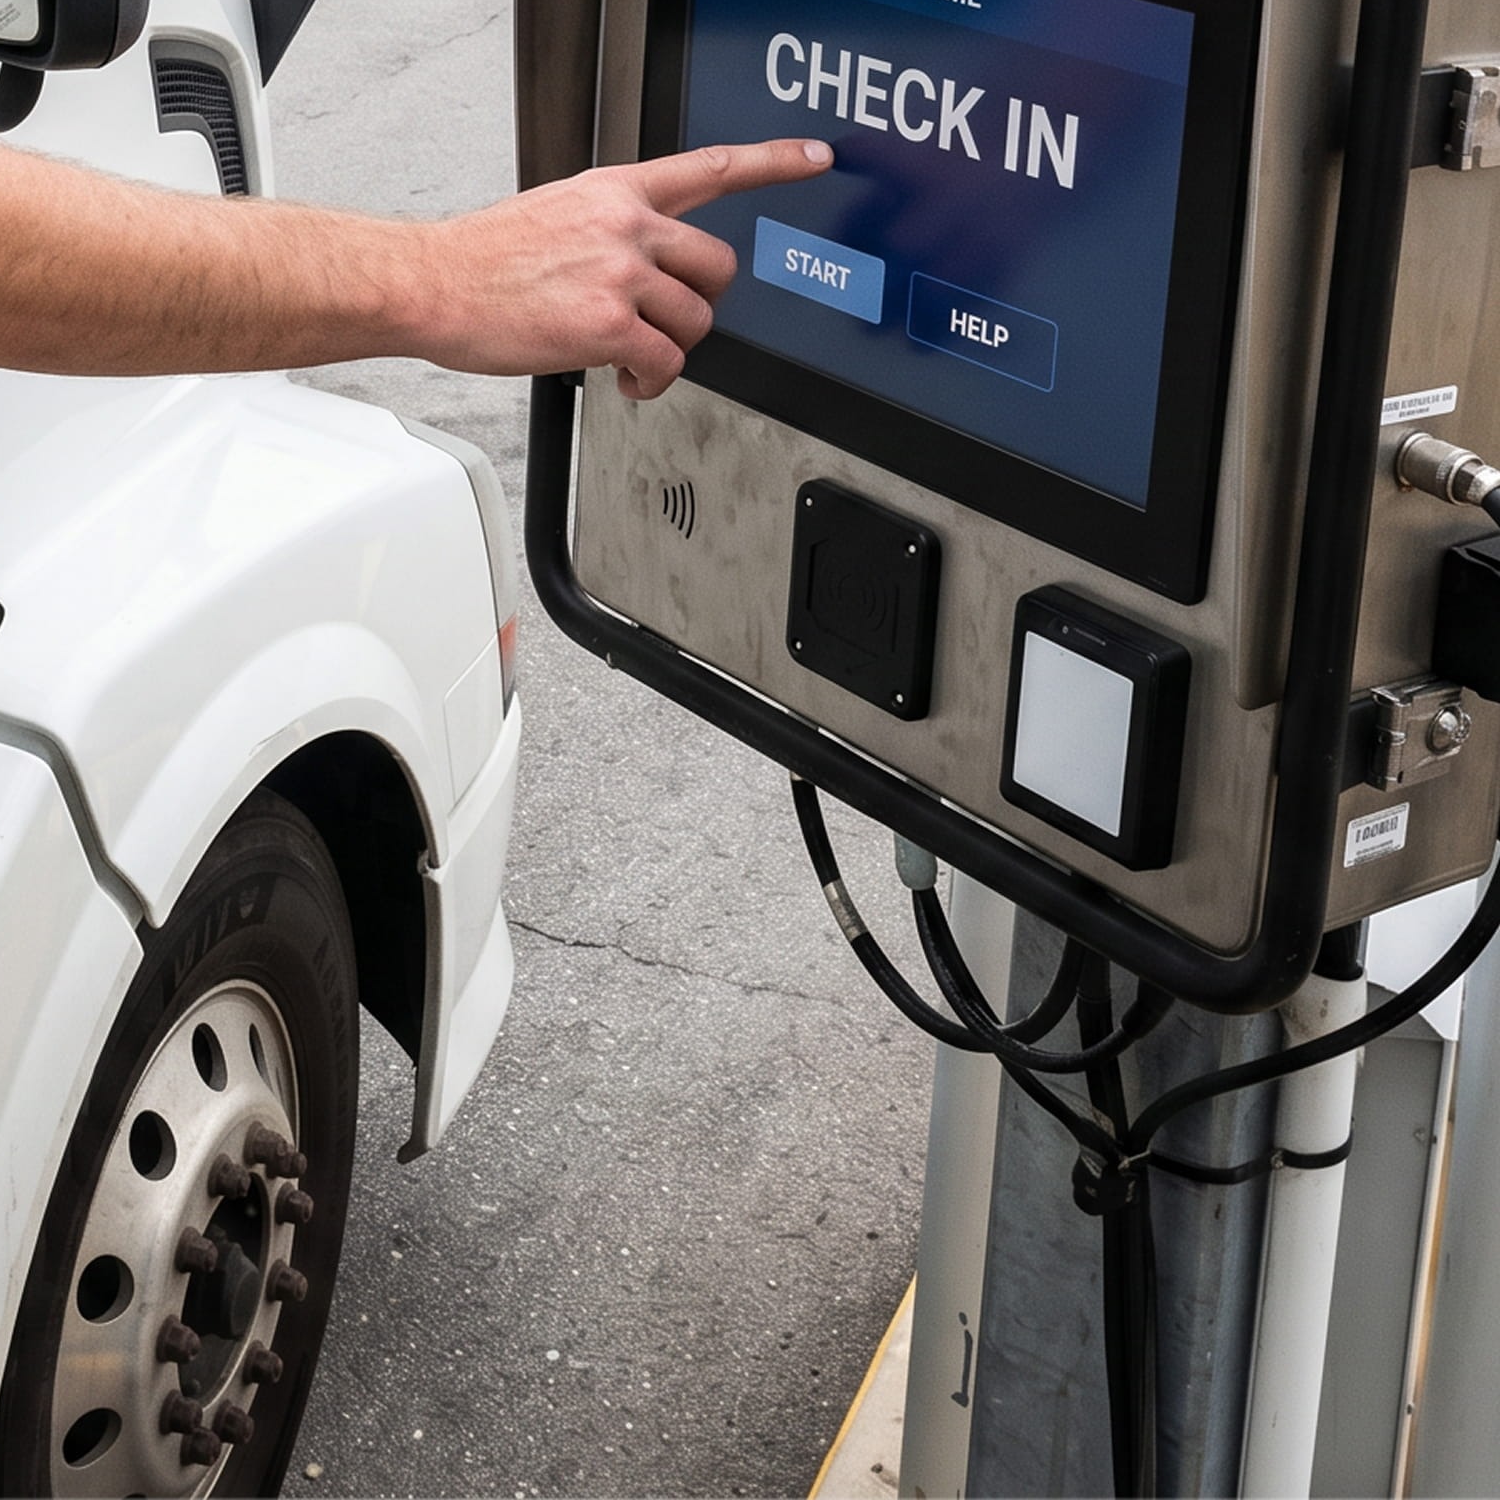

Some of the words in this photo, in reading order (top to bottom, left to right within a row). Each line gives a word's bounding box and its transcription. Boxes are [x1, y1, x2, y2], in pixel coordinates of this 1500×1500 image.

[765, 31, 986, 162] CHECK
[1003, 97, 1080, 190] IN
[784, 248, 852, 291] START
[949, 308, 1010, 349] HELP
